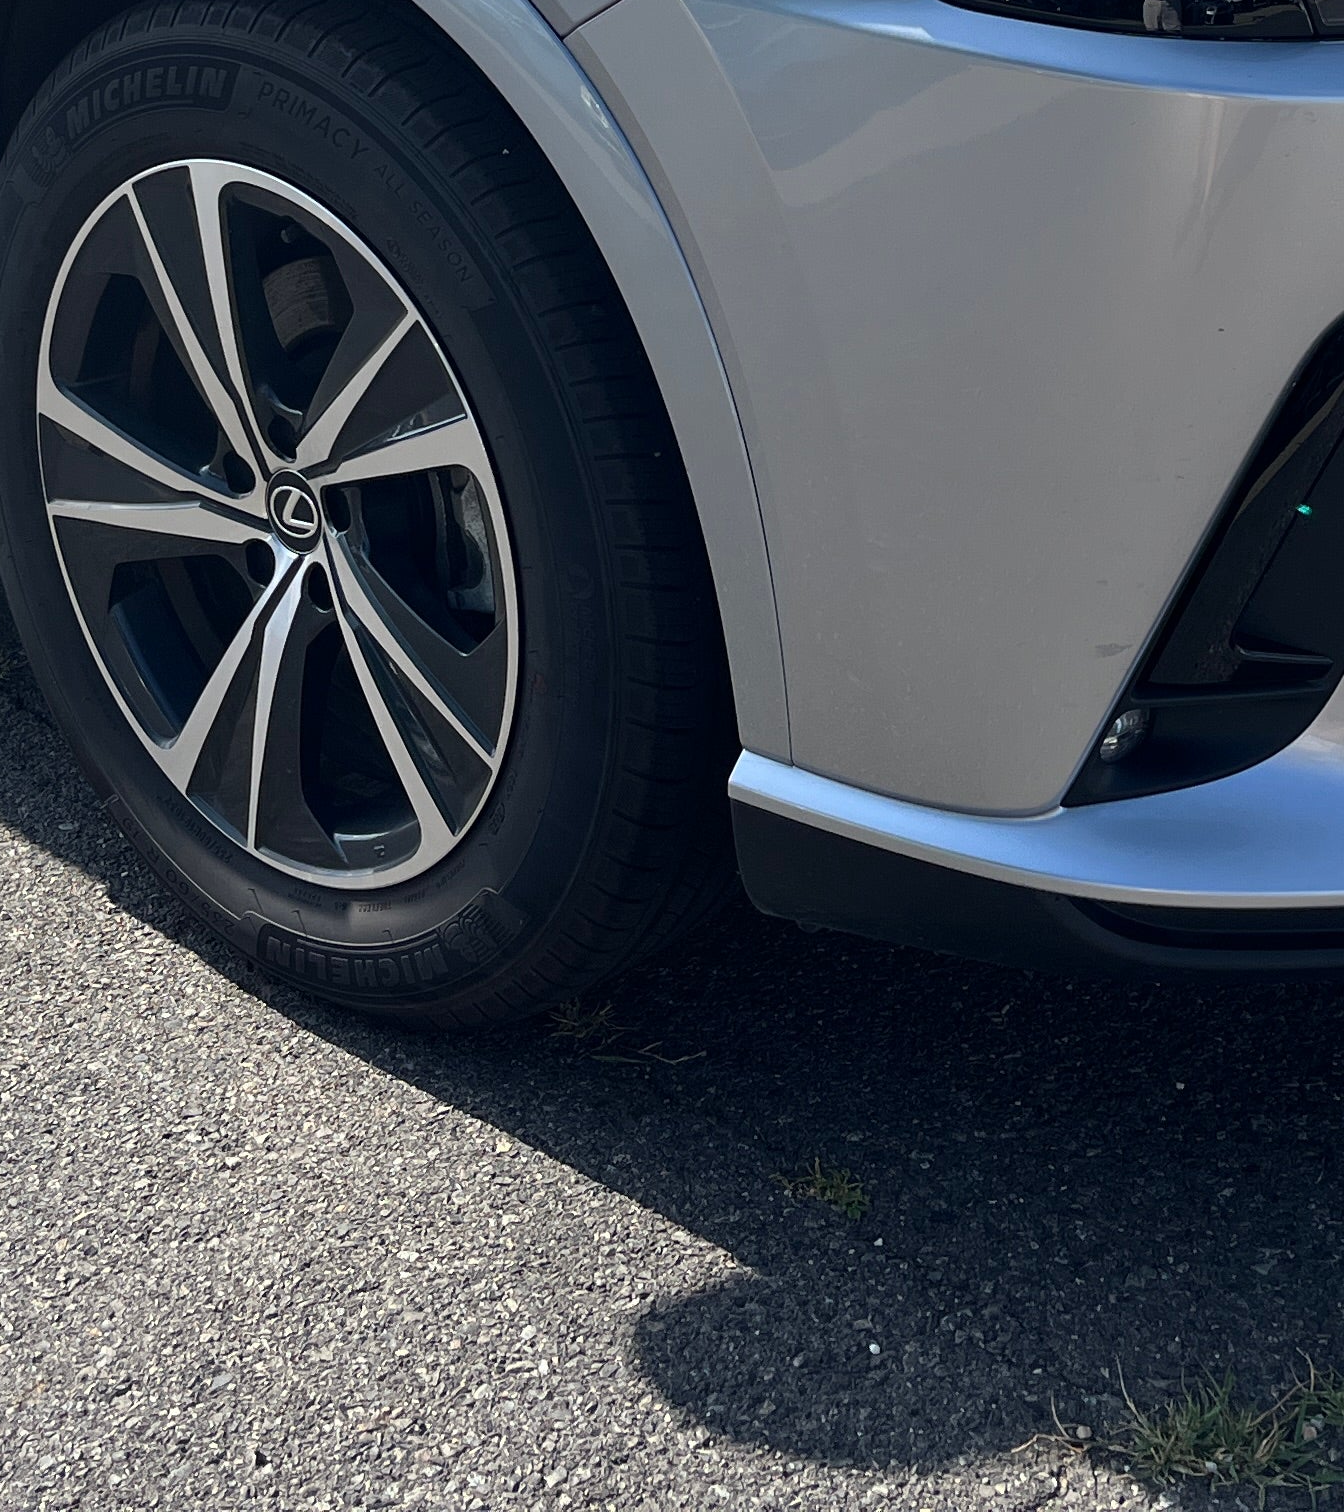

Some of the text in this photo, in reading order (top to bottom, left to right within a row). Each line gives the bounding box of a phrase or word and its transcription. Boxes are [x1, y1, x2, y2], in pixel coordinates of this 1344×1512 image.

[66, 65, 227, 140] MICHELIN
[257, 81, 369, 160] PRIMACY
[374, 163, 407, 200] ALL
[408, 200, 474, 285] SEASON
[266, 935, 449, 988] MICHELIN
